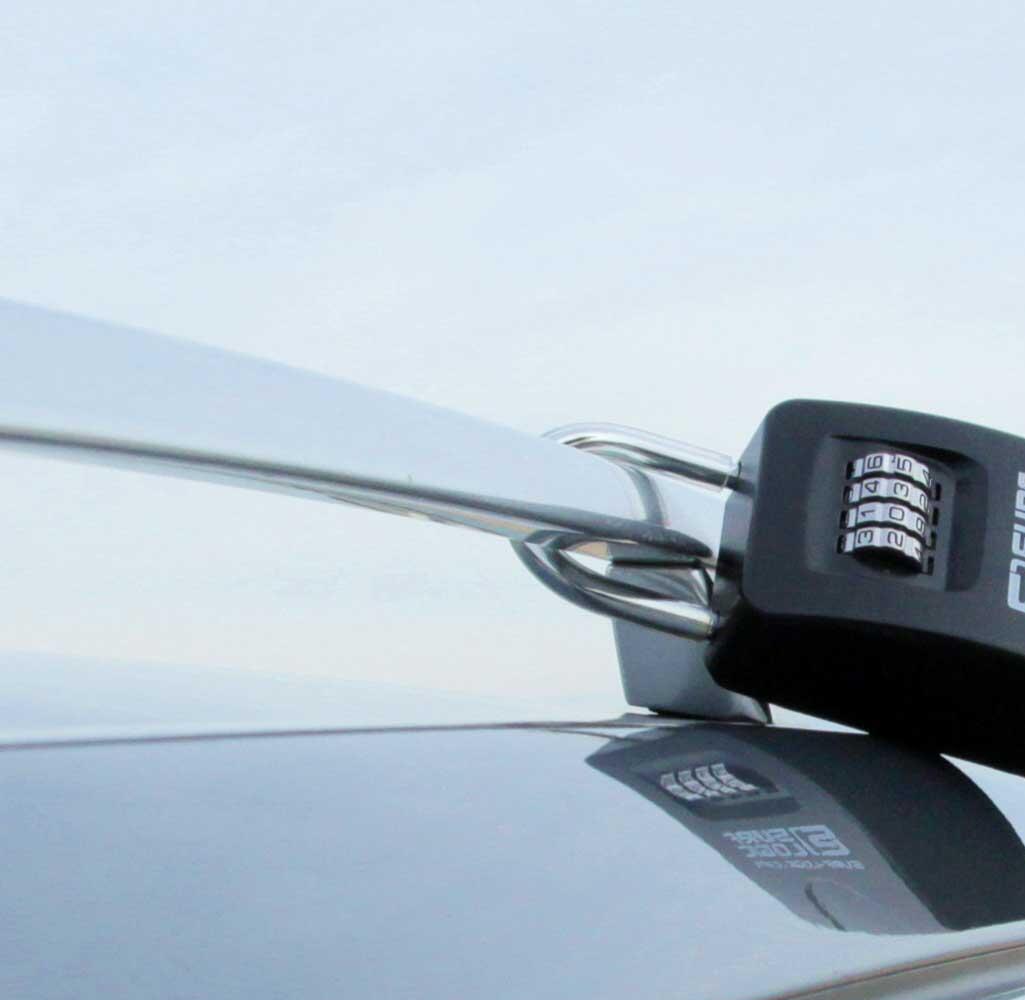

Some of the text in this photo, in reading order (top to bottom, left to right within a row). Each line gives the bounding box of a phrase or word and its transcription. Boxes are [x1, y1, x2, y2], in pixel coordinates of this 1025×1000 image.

[867, 455, 884, 470] 6
[864, 479, 880, 494] 4
[893, 482, 910, 498] 3
[888, 505, 906, 522] 0
[857, 530, 875, 545] 3
[886, 531, 905, 548] 2
